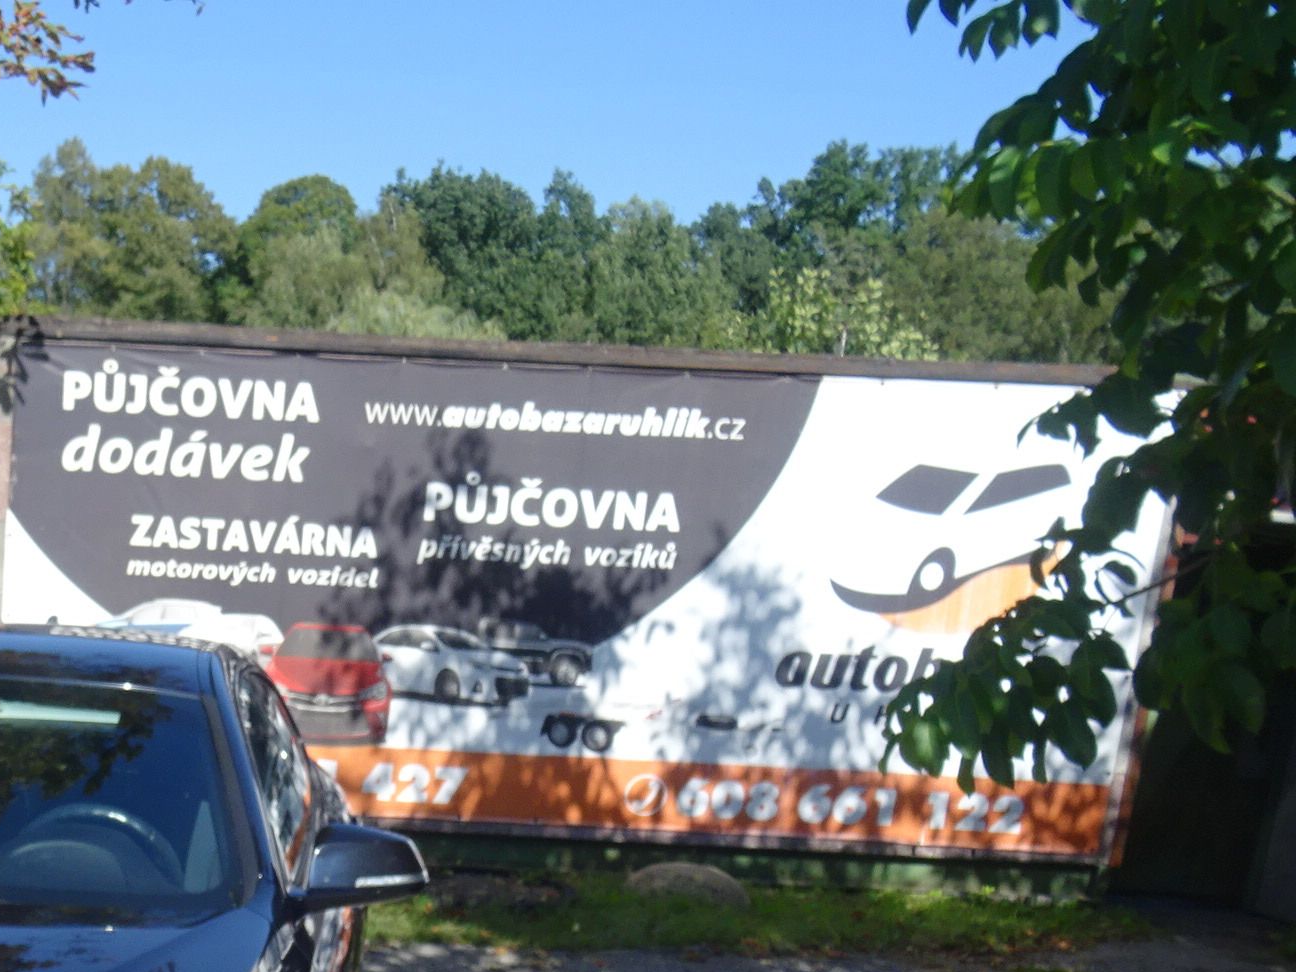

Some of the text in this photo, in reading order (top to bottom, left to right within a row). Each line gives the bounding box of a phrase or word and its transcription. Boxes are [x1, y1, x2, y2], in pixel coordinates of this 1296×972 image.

[62, 358, 320, 423] PŮJČOVNA
[364, 401, 746, 441] www.autobazaruhlik.cz
[60, 423, 311, 483] dodávek
[422, 471, 680, 533] PŮJČOVNA
[129, 514, 378, 559] ZASTAVÁRNA
[417, 535, 679, 570] přívěsných vozíků
[126, 558, 379, 589] motorových vozidel
[362, 761, 470, 805] 427
[677, 776, 1024, 835] 608 661 122
